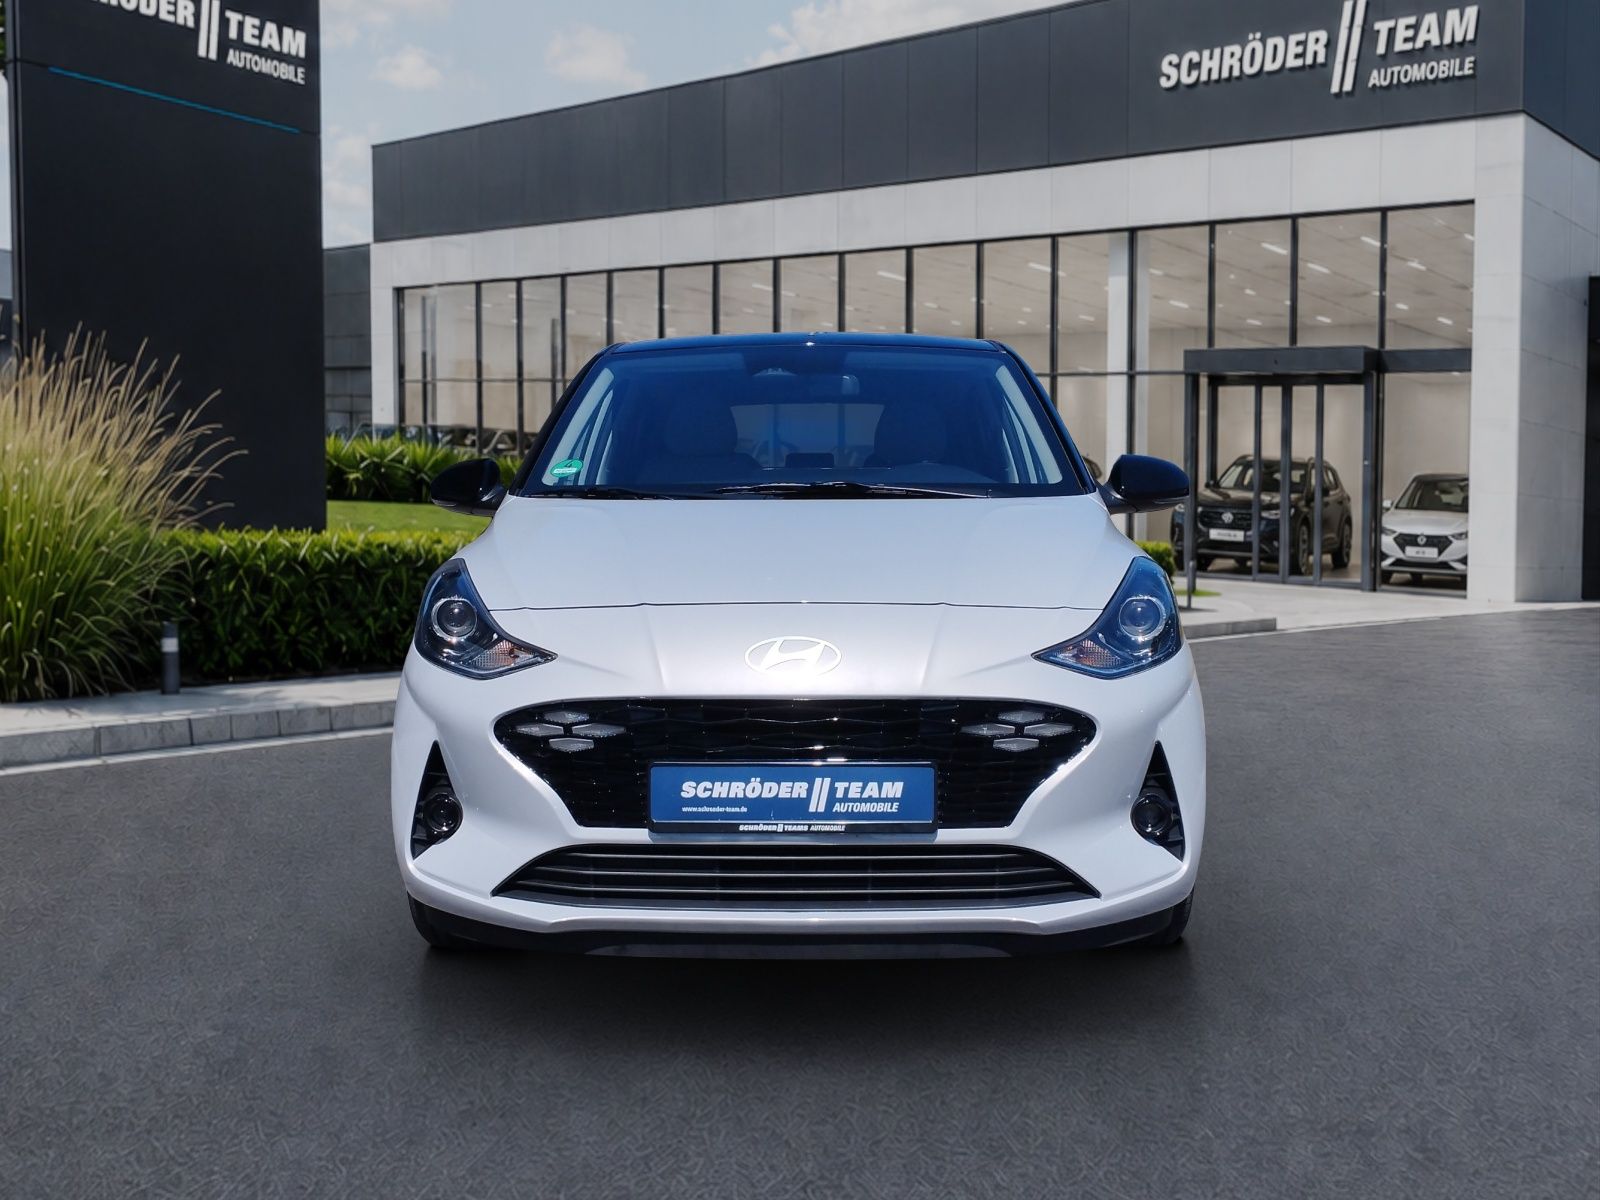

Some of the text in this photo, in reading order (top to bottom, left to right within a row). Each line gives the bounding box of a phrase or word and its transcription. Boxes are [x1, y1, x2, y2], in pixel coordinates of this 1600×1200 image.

[225, 9, 306, 59] TEAM
[1159, 5, 1479, 88] SCHRÖDER TEAM
[226, 48, 305, 85] AUTOMOBILE
[1368, 56, 1475, 88] AUTOMOBILE
[680, 778, 904, 799] SCHRÖDER TEAM
[832, 802, 900, 813] AUTOMOBILE
[738, 823, 777, 832] SCHRÖDER
